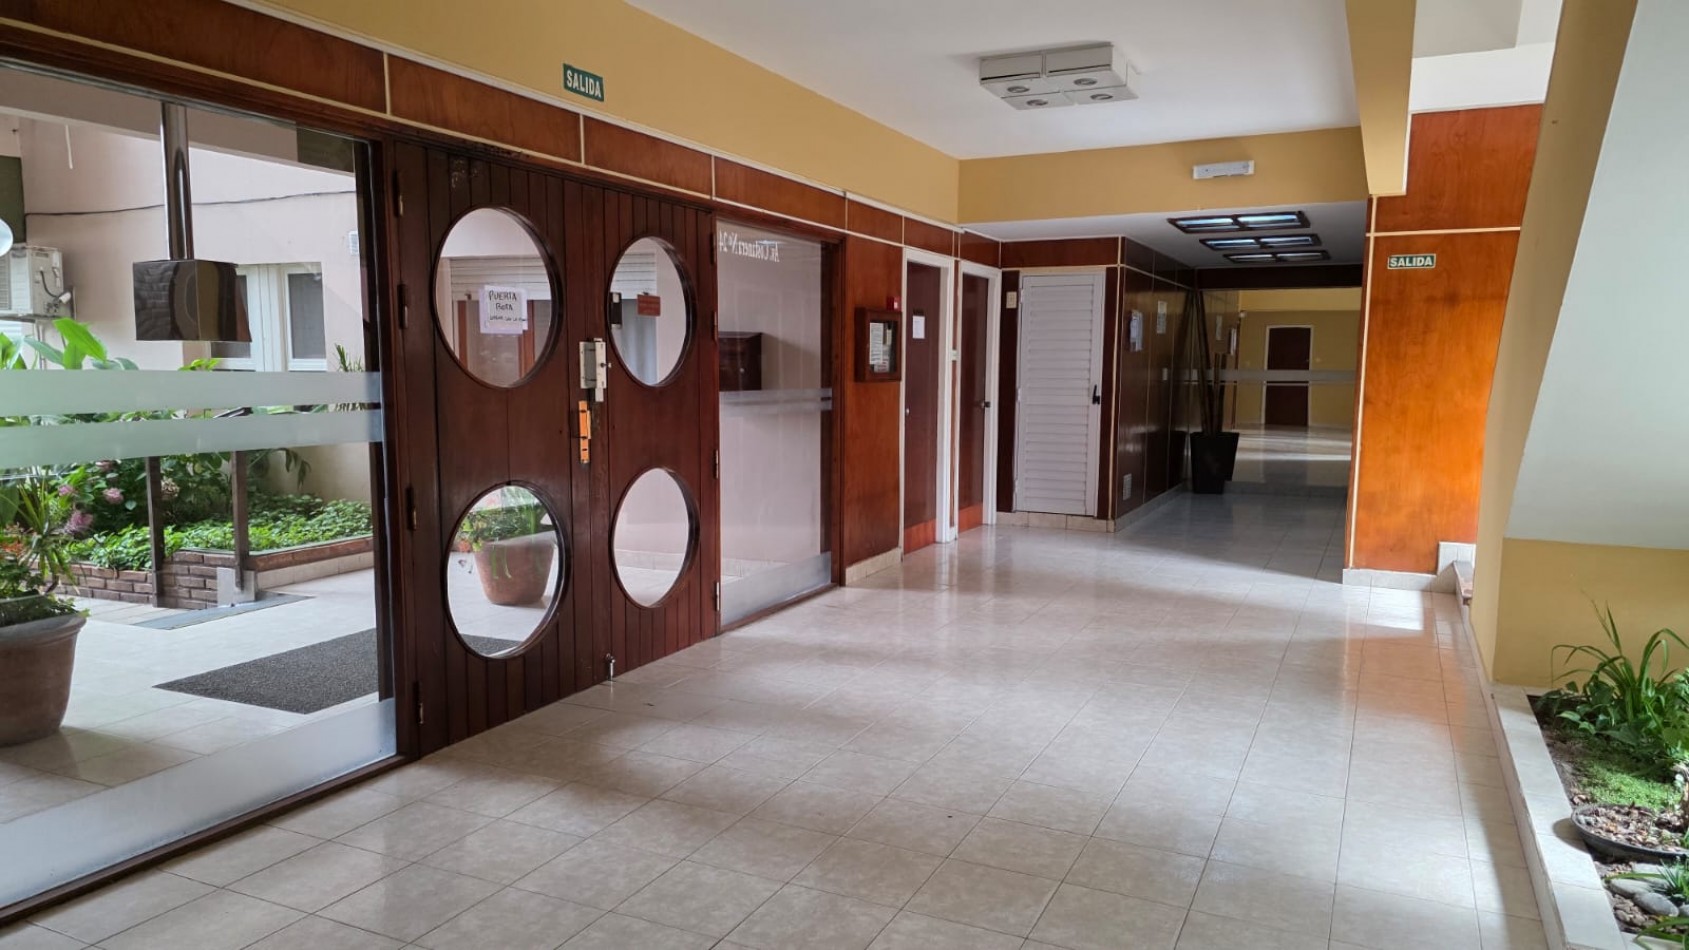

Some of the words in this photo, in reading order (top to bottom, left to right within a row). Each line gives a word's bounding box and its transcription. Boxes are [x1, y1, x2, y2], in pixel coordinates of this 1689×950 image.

[566, 70, 602, 98] SALIDA
[1390, 256, 1433, 267] SALIDA
[488, 289, 518, 301] PUERTA
